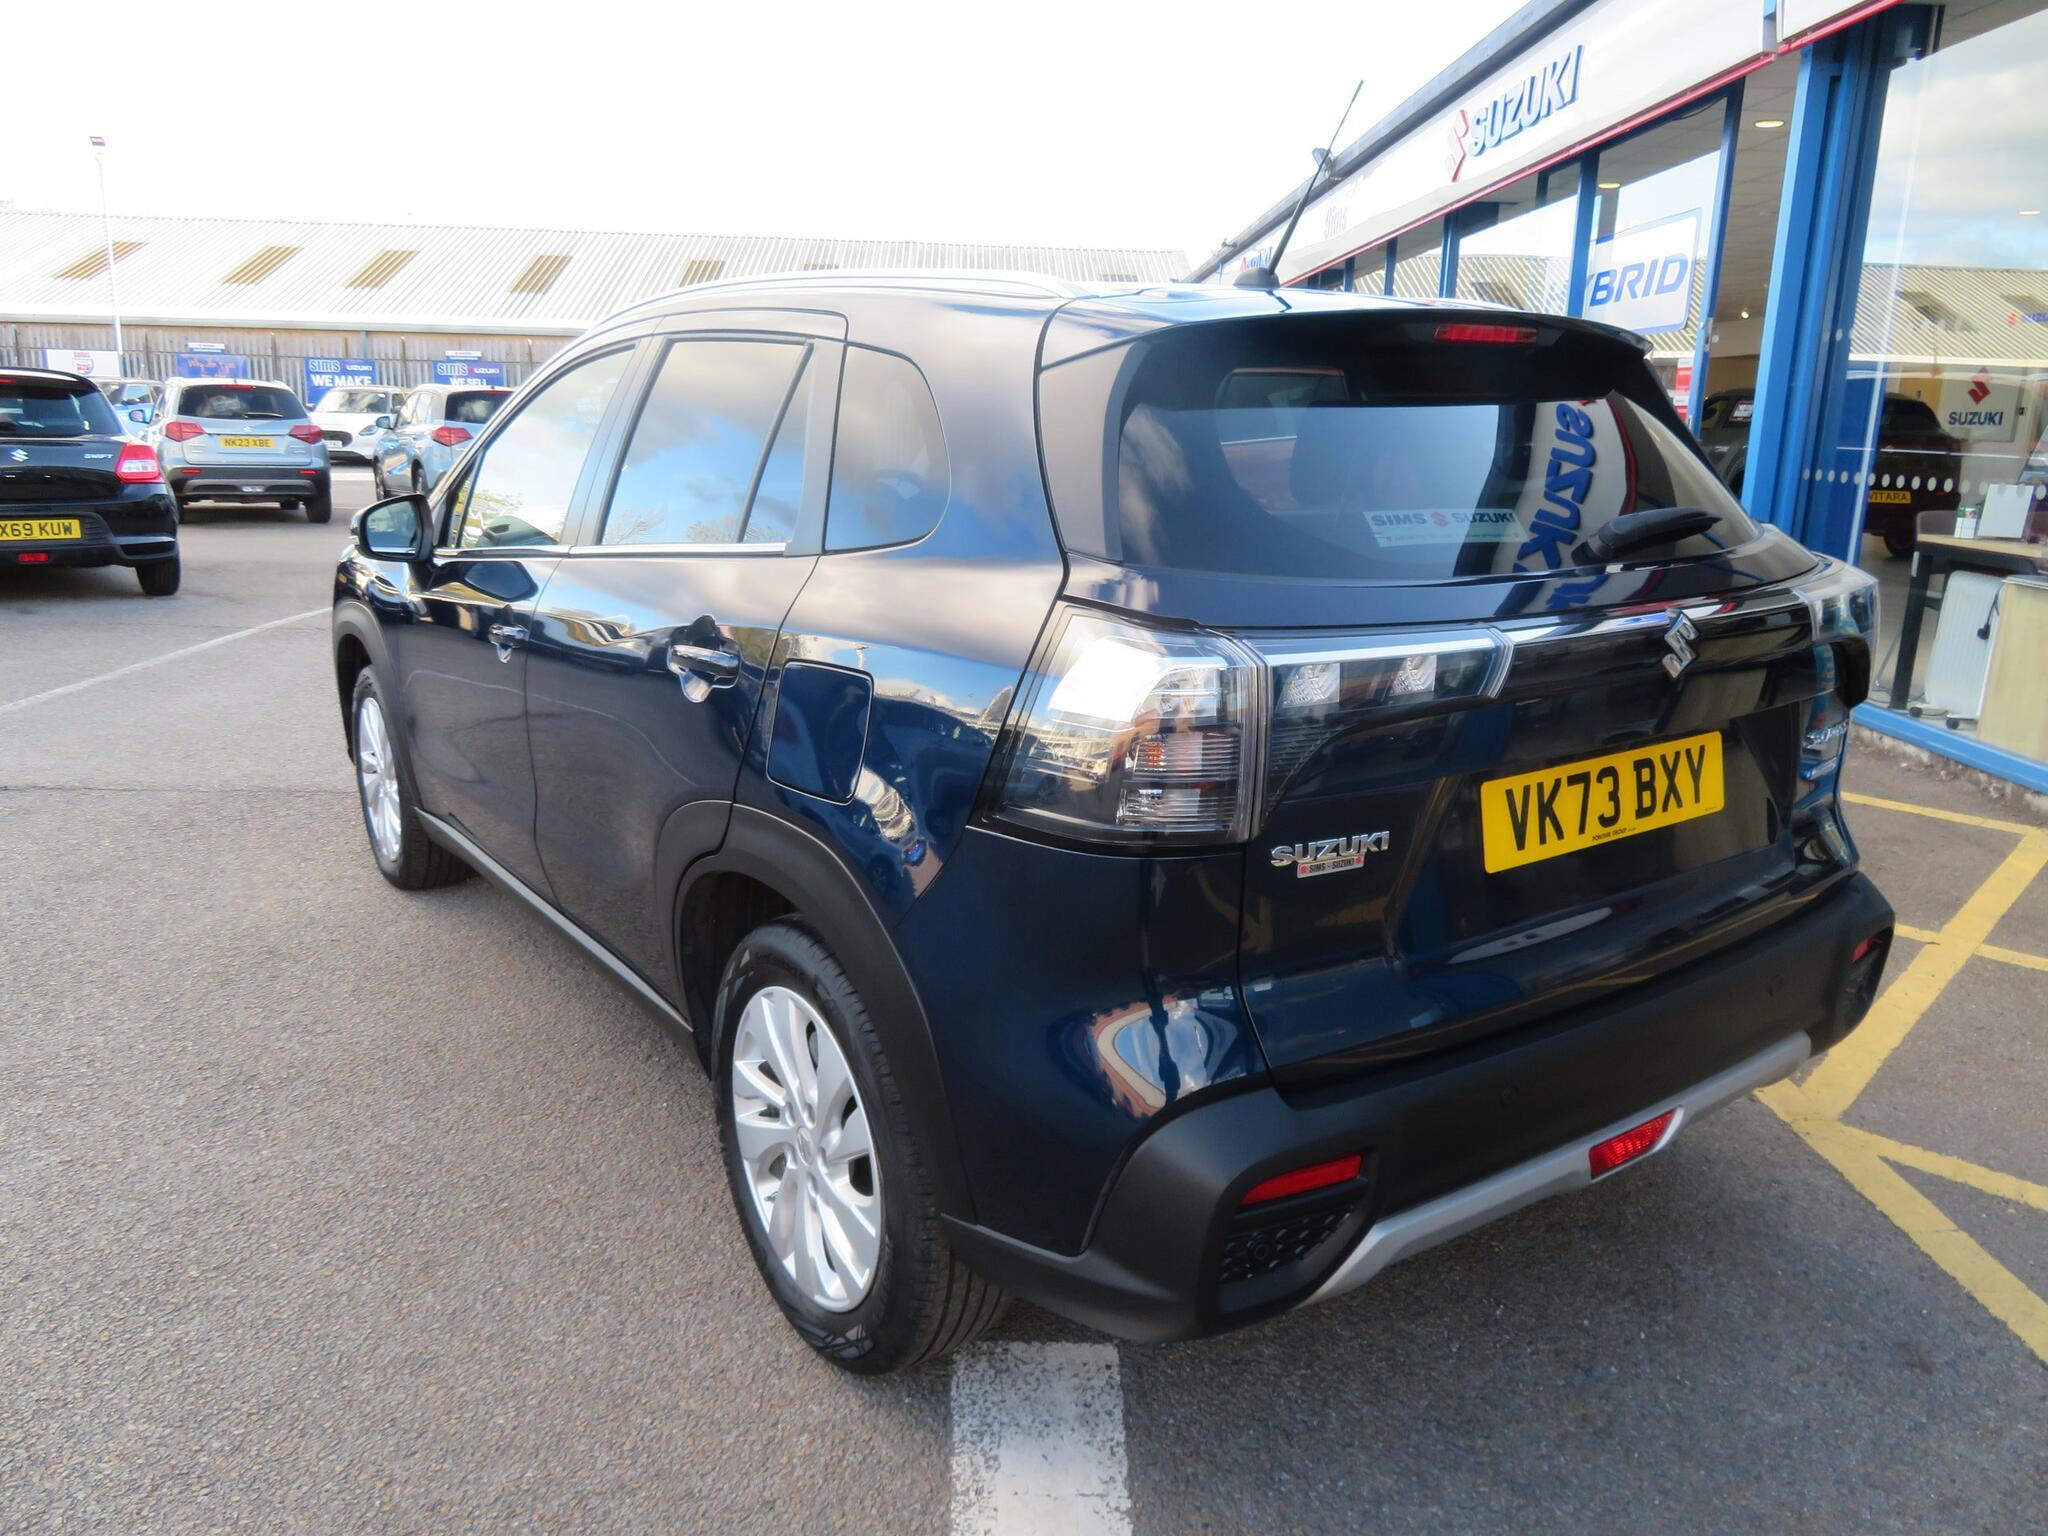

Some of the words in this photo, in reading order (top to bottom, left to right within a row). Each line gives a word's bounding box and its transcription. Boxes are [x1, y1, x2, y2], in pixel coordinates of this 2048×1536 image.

[1469, 45, 1584, 157] SUZUKI
[311, 375, 334, 386] WE
[335, 375, 372, 387] MAKE
[449, 377, 466, 385] WE
[1948, 411, 2003, 426] SUZUKI
[224, 438, 250, 447] NK23
[253, 438, 271, 447] XBE
[1372, 513, 1427, 527] SIMS
[1451, 512, 1514, 524] SUZUKI
[39, 522, 73, 536] KUW
[1505, 766, 1621, 851] VK73
[1633, 745, 1706, 820] BXY
[1270, 831, 1390, 867] SUZUKI
[1309, 862, 1326, 873] SIMS
[1332, 858, 1355, 869] SUZUKI
